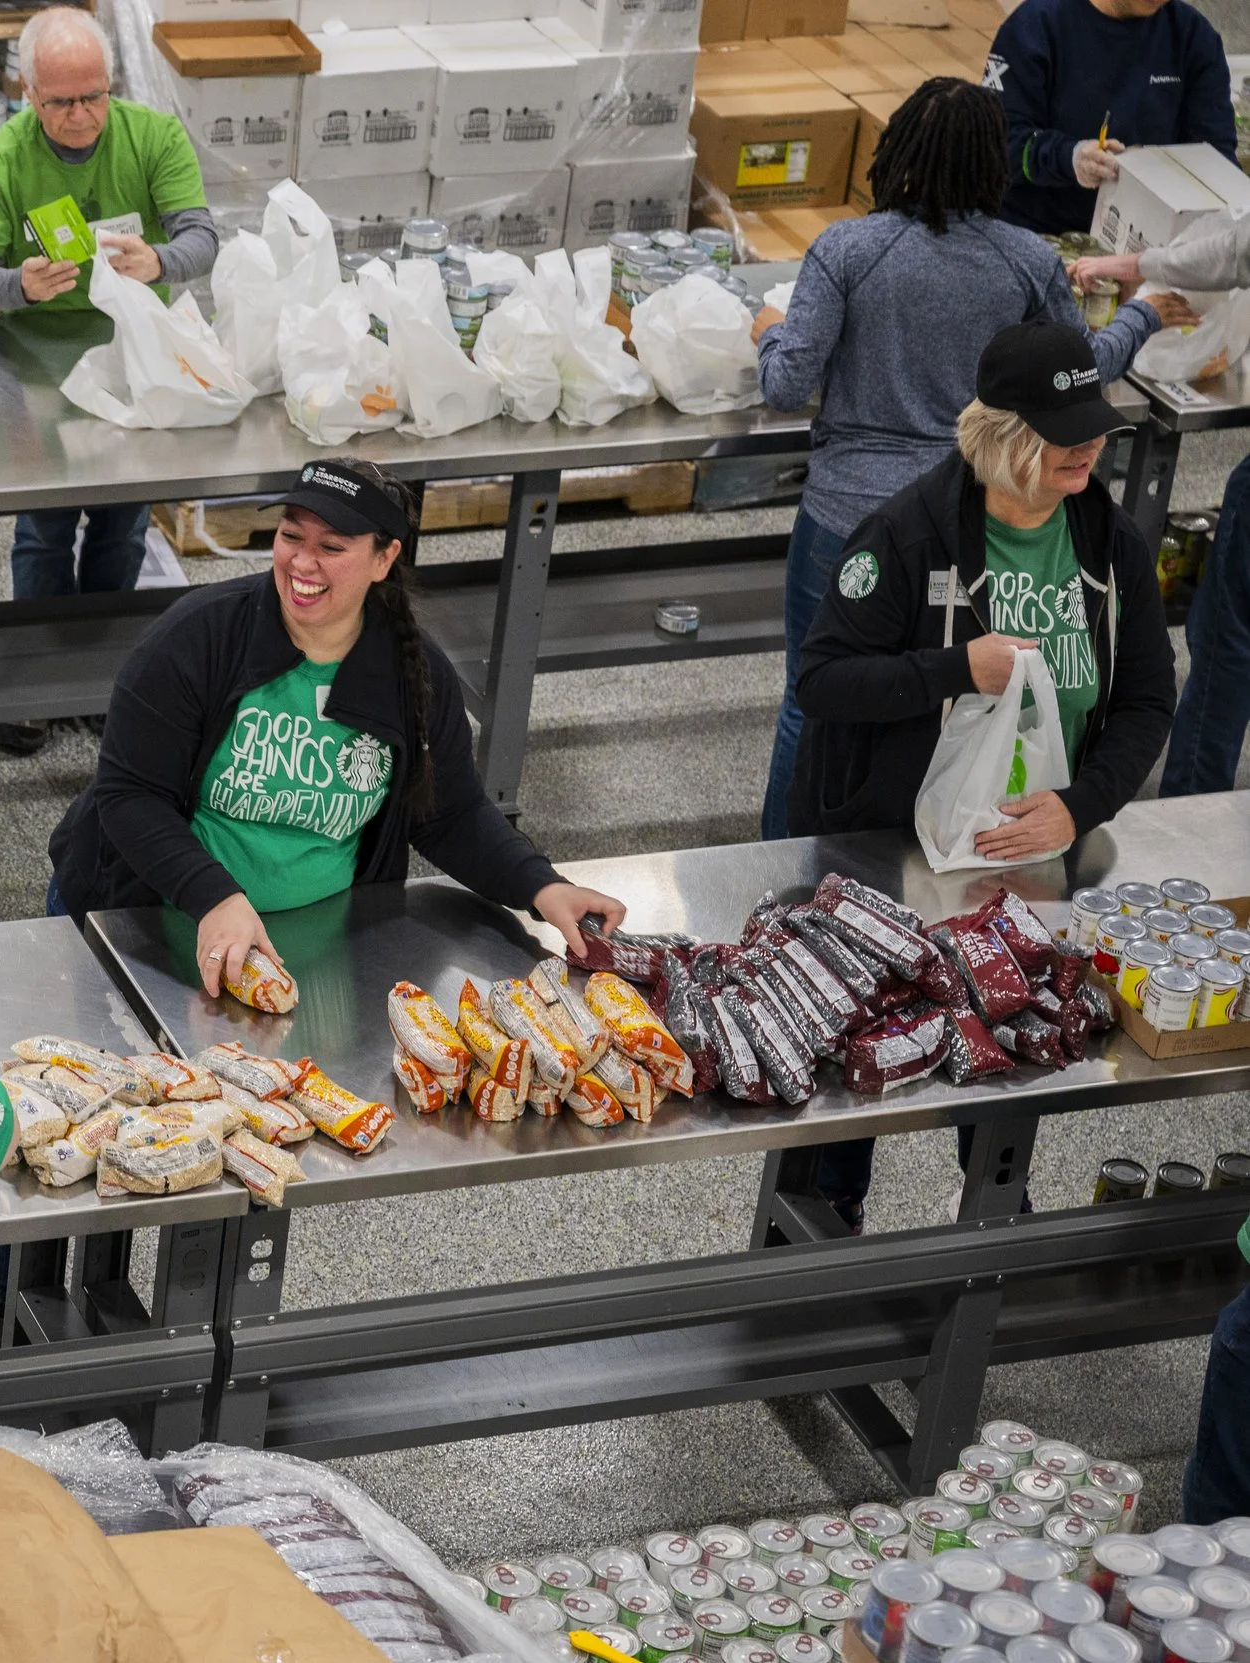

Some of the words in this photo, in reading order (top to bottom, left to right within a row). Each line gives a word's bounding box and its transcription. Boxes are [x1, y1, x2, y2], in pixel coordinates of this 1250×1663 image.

[312, 476, 357, 497] FOUNDATION
[314, 470, 359, 491] STARBUCKS
[986, 570, 1034, 603] OOD
[232, 707, 312, 754] GOOD
[230, 735, 336, 788] THINGS
[219, 766, 268, 794] ARE
[958, 932, 984, 968] BEANS
